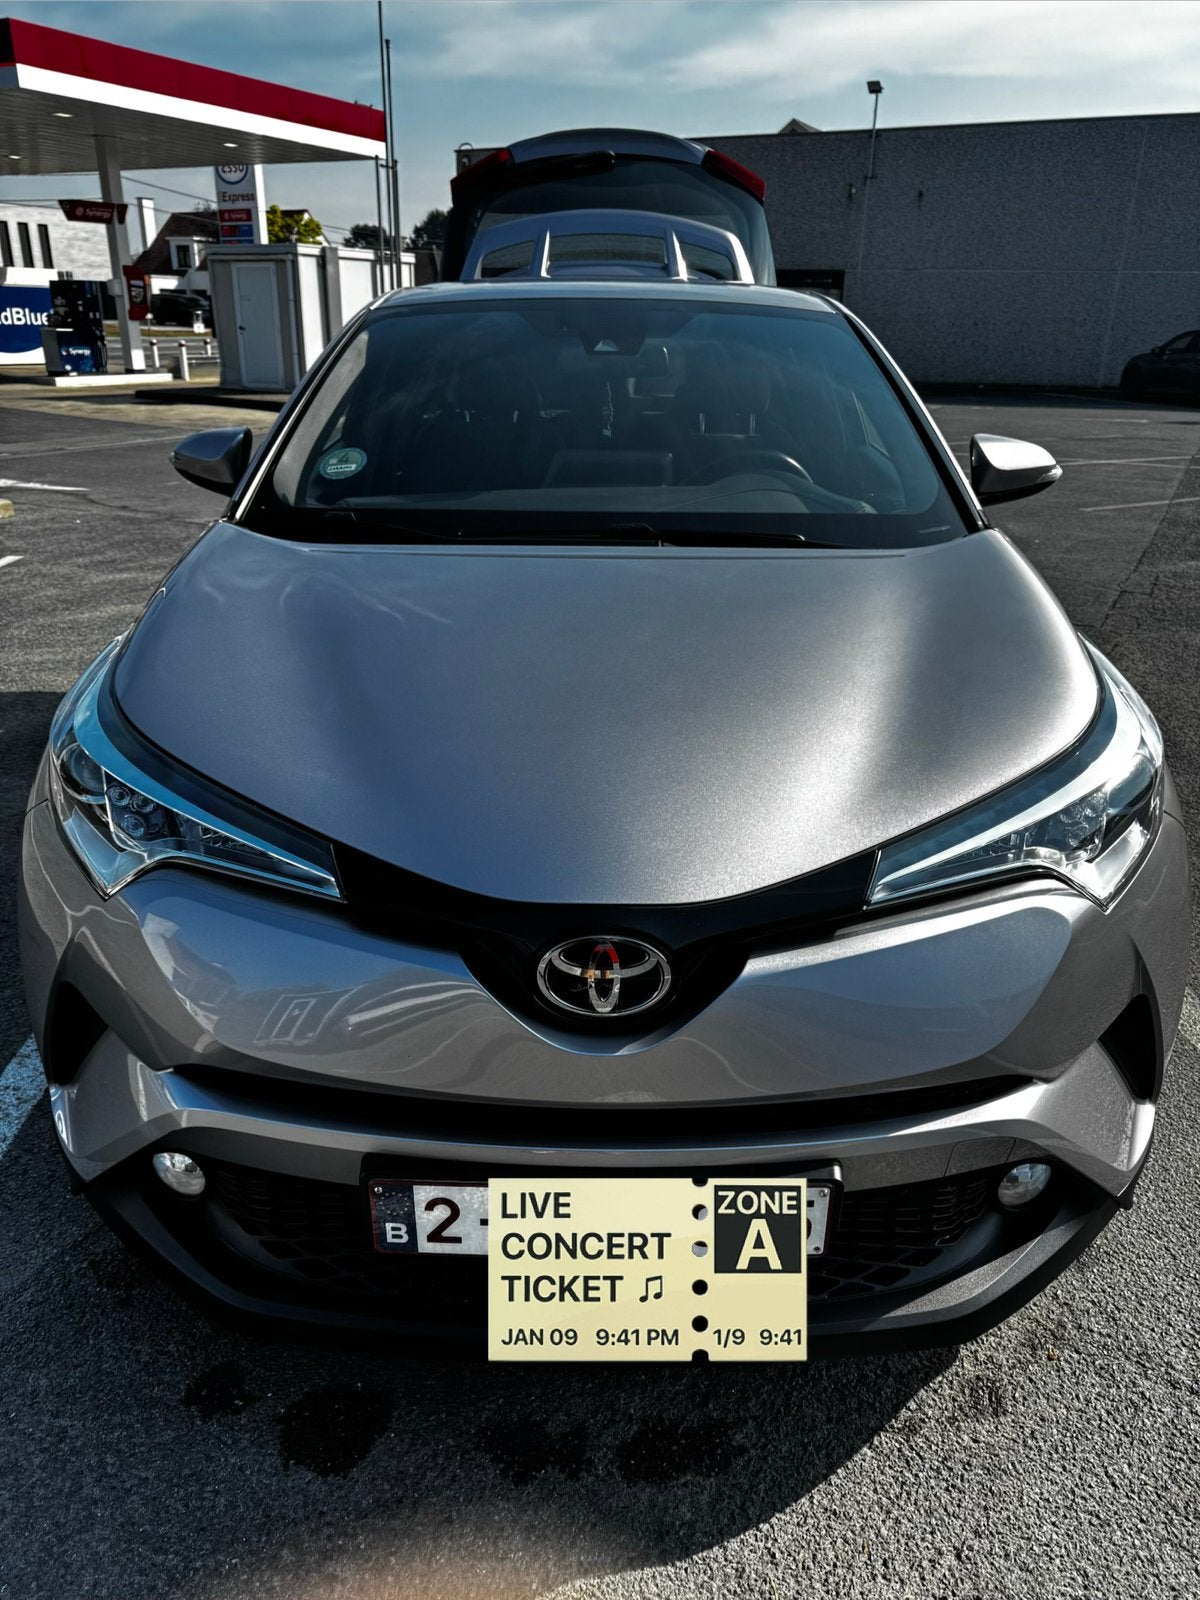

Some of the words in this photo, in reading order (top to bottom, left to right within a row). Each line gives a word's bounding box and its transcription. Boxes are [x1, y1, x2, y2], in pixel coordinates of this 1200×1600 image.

[222, 191, 256, 204] Express
[0, 307, 48, 326] dBlue
[69, 347, 91, 356] Synergy
[385, 1222, 409, 1243] B
